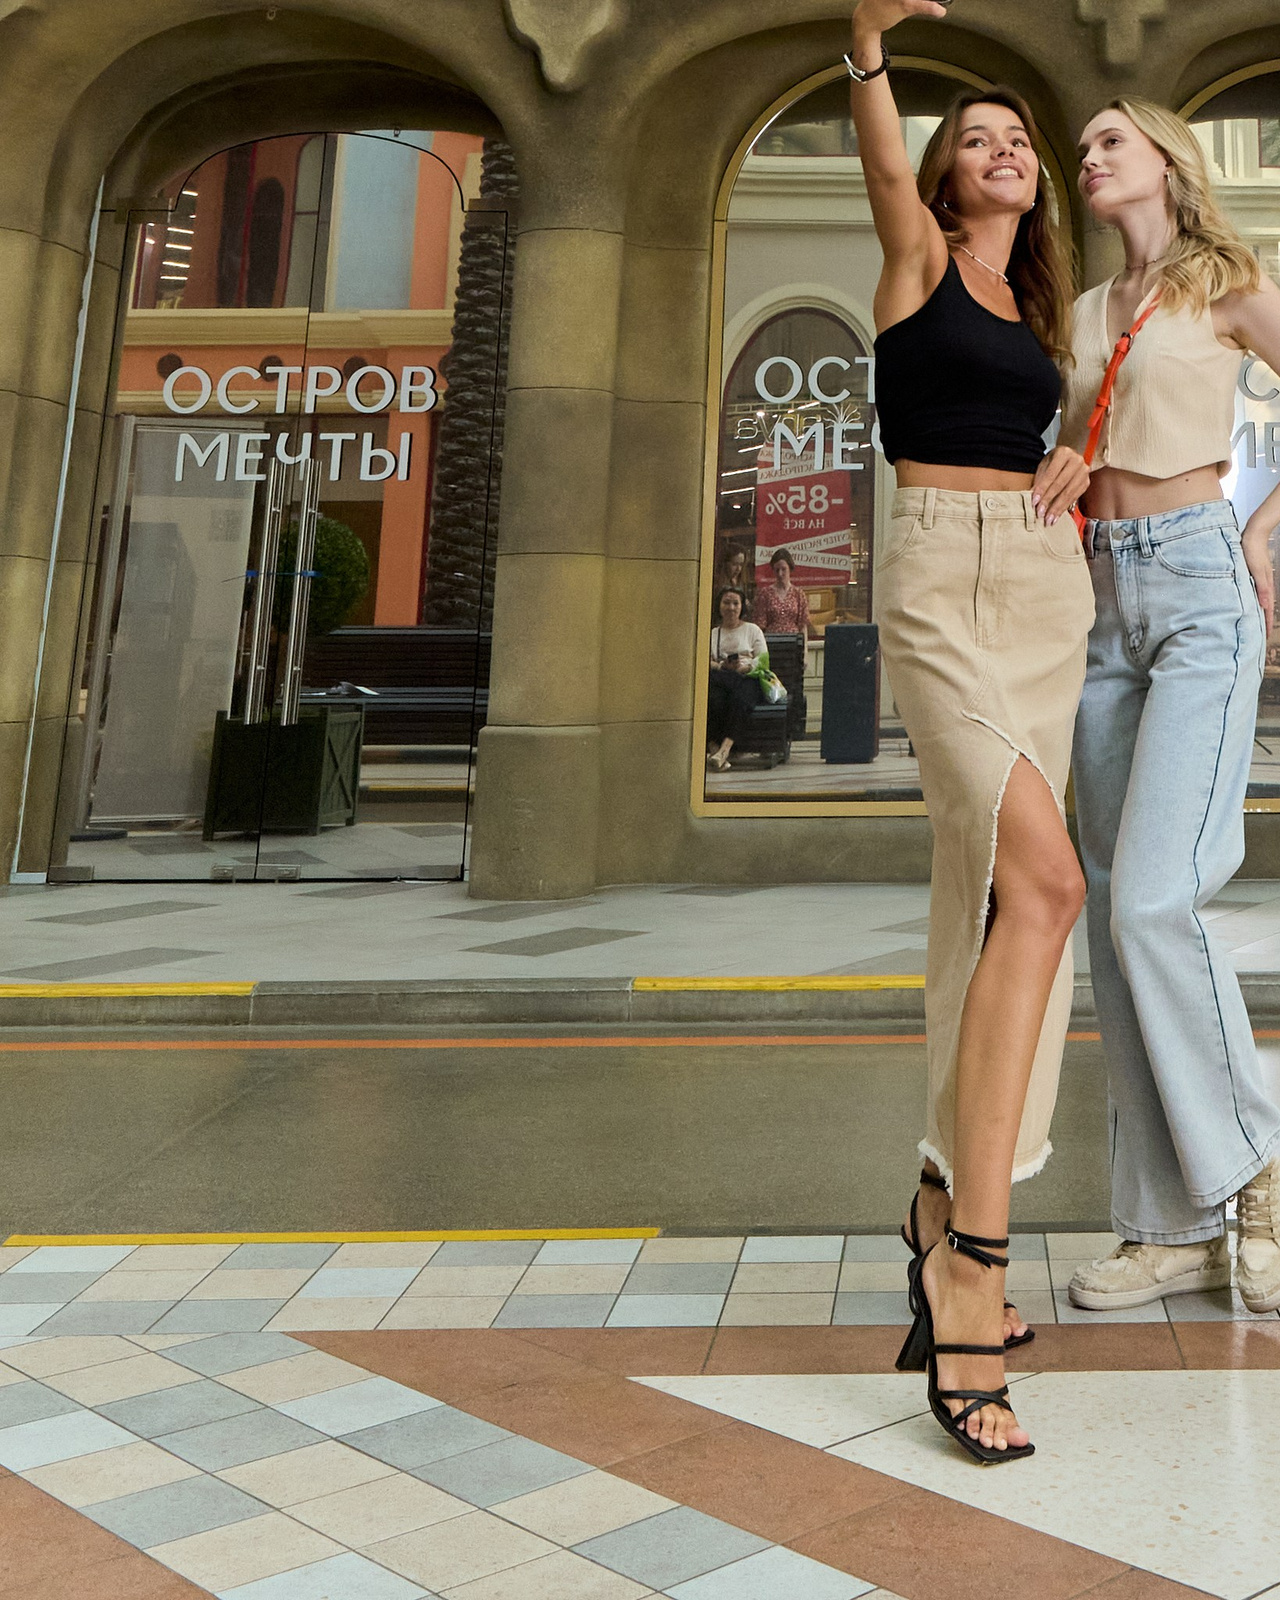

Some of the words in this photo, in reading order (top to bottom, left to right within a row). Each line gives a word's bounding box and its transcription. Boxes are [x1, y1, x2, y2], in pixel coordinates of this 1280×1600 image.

[163, 365, 438, 414] ОСТРОВ
[755, 356, 876, 404] ОСТ
[175, 432, 412, 481] МЕЧТЫ
